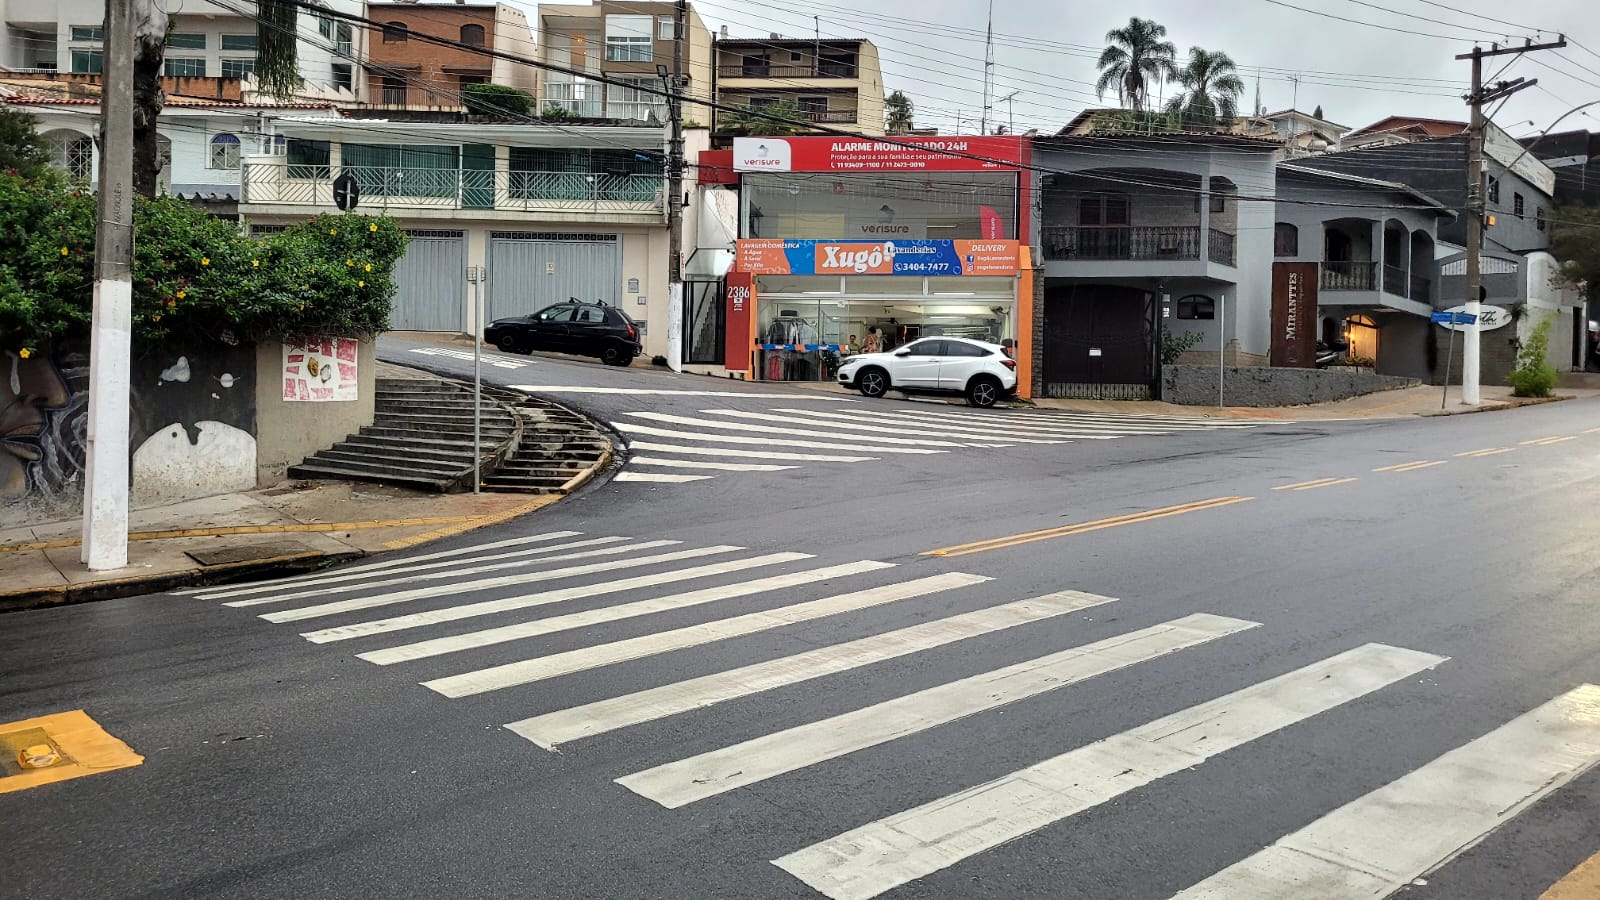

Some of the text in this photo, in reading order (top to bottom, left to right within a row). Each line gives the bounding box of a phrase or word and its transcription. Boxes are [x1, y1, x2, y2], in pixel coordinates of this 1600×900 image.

[831, 142, 872, 152] ALARME
[946, 141, 968, 151] 24H
[830, 153, 857, 161] Proteção
[861, 224, 909, 233] verisure
[767, 241, 800, 249] DOMÉSTICA
[971, 244, 1007, 252] DELIVERY
[822, 245, 883, 273] Xugô
[902, 262, 949, 271] 3404-7477
[727, 286, 750, 299] 2386
[1286, 272, 1297, 340] MIRANTTES
